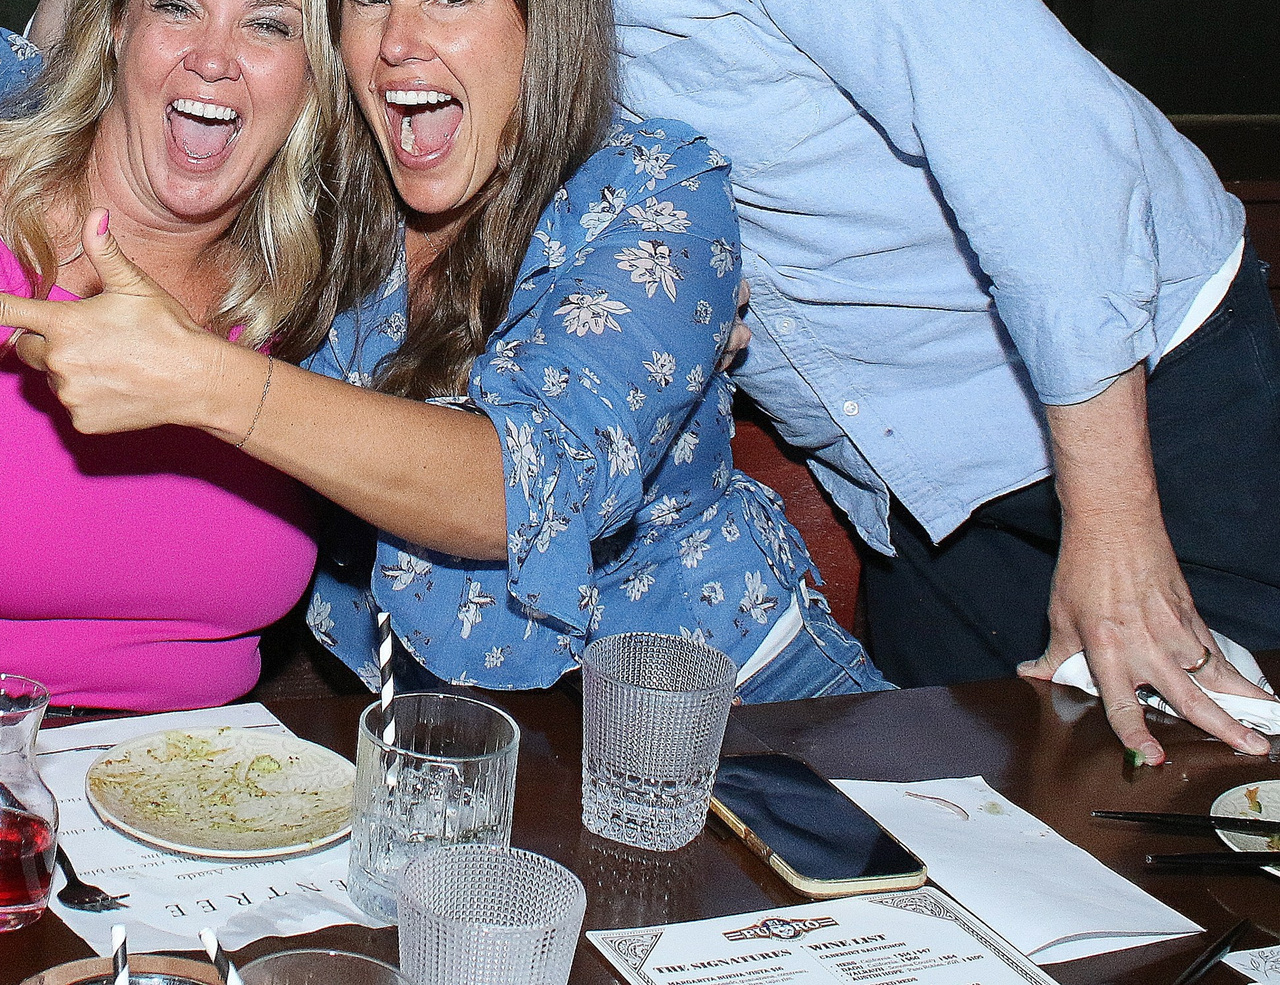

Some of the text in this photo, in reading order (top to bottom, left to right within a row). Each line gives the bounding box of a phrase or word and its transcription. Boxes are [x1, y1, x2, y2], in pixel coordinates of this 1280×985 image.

[109, 864, 135, 873] and
[176, 868, 225, 881] Asado
[165, 879, 350, 918] ENTREE
[808, 933, 887, 951] WINE LIST
[653, 949, 792, 974] THE SIGNATURES
